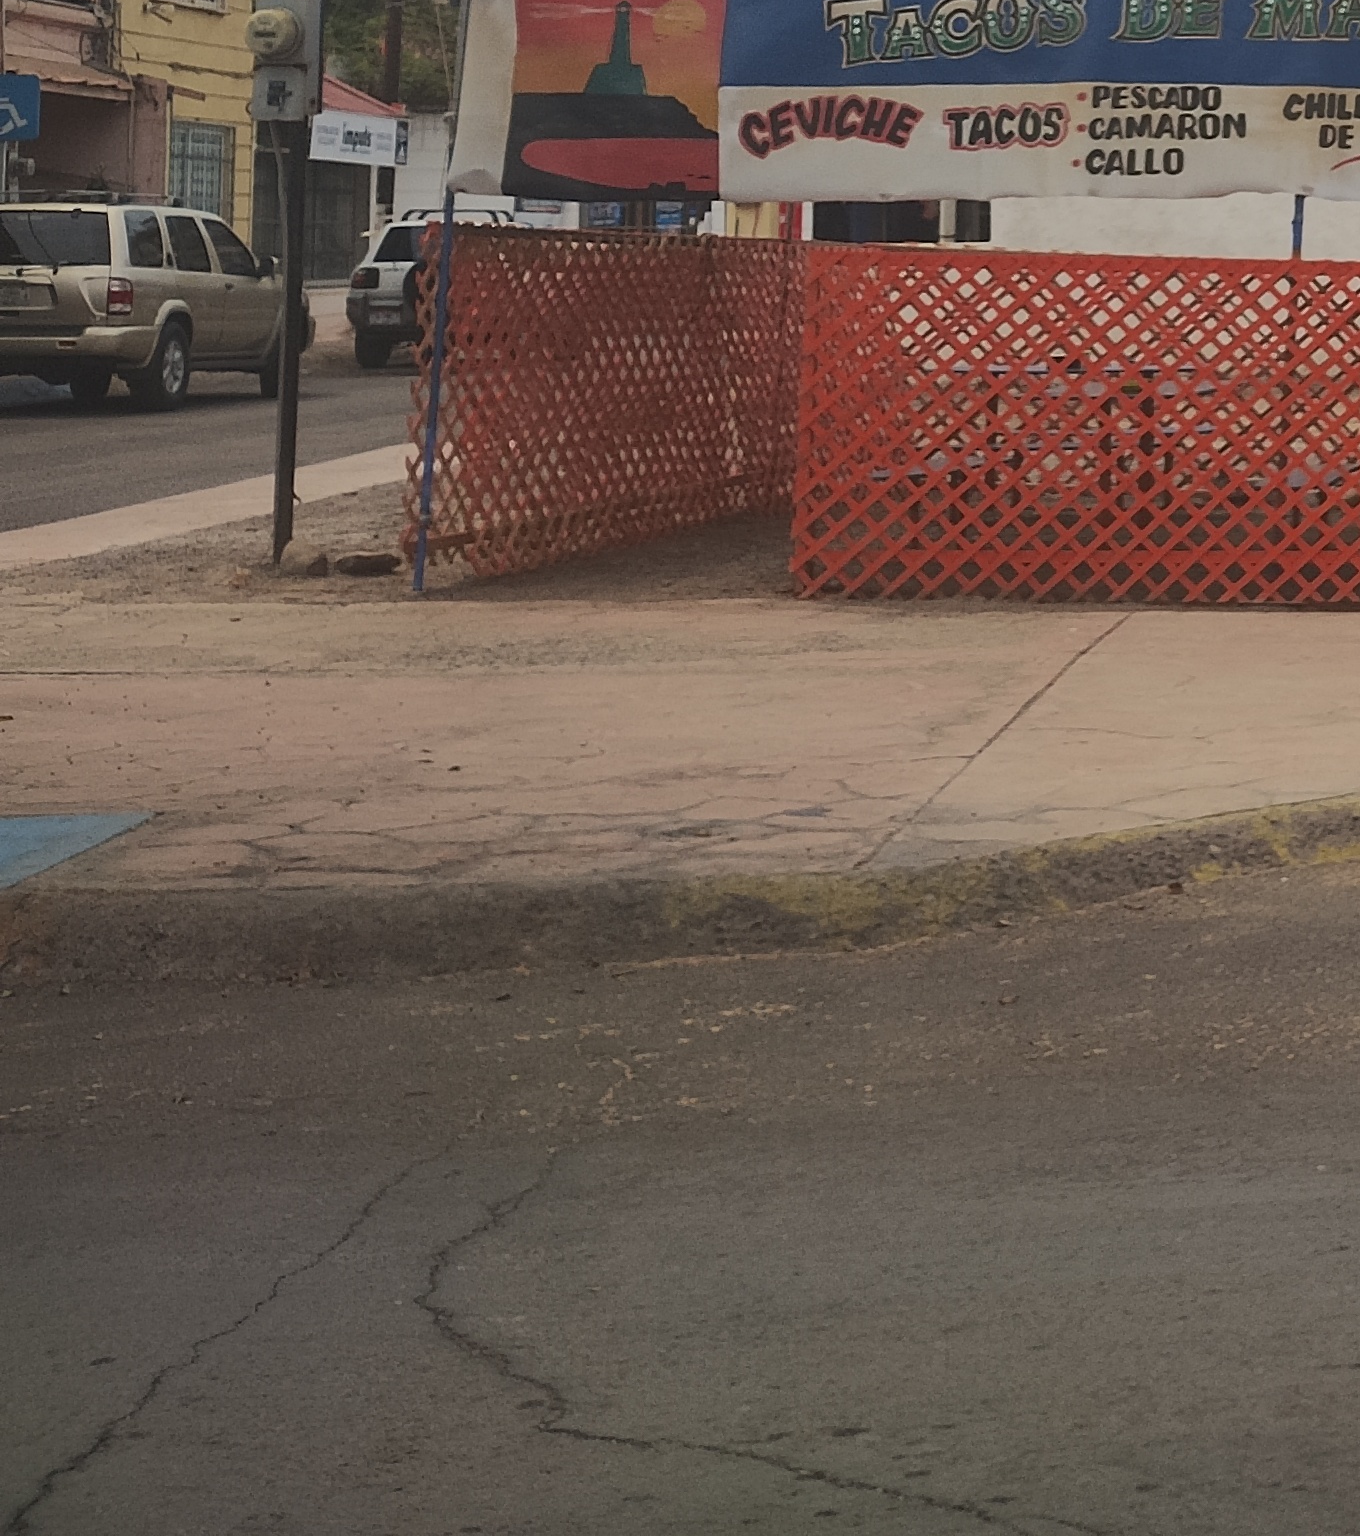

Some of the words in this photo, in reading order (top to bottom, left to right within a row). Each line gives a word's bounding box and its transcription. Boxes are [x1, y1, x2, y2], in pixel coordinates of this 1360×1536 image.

[1091, 85, 1222, 112] PESCADO
[738, 95, 924, 159] CEVICHE
[943, 103, 1070, 150] TACOS
[1088, 113, 1247, 141] CAMARON
[1318, 124, 1354, 150] DE
[1084, 148, 1185, 176] CALLO
